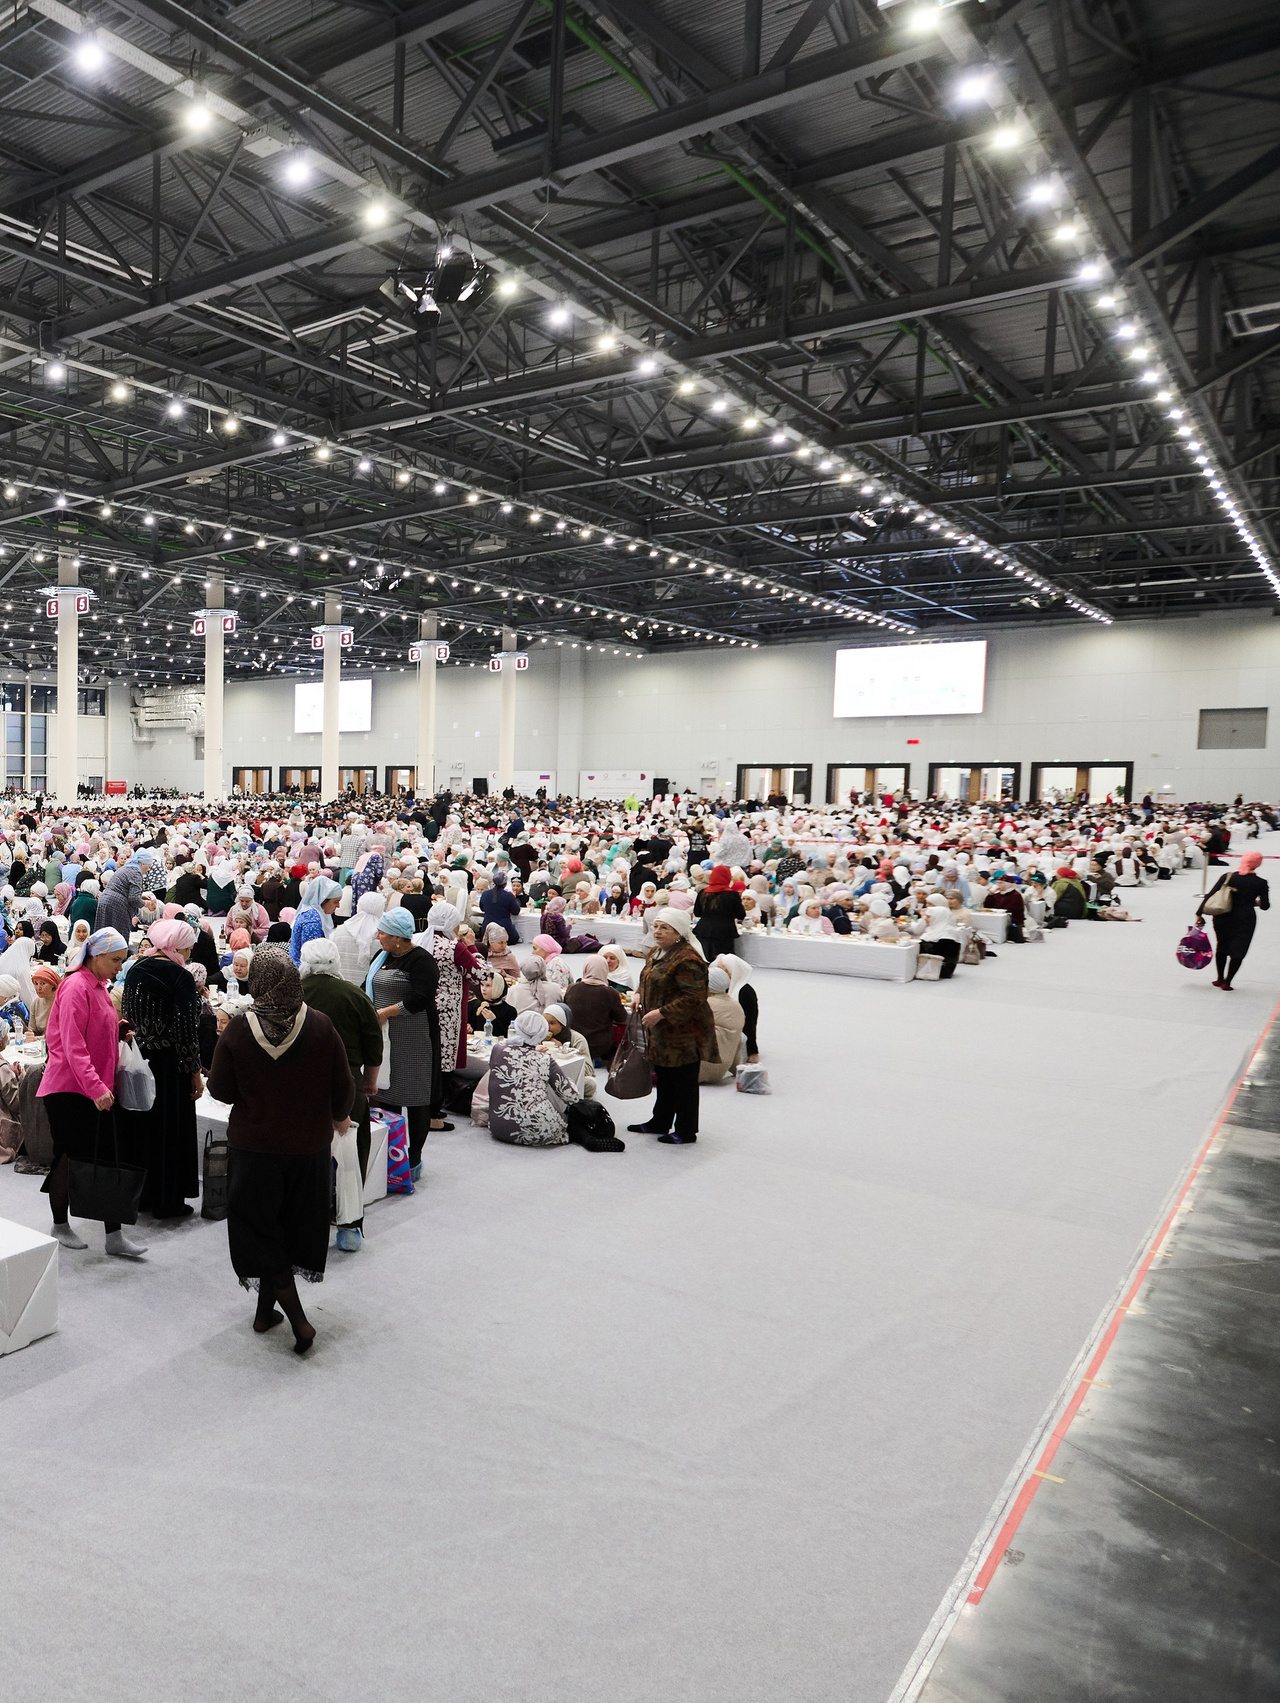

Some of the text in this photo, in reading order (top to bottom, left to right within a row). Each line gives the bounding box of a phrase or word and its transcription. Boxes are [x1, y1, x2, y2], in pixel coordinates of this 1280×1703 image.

[50, 602, 56, 613] 5
[79, 598, 85, 610] 5
[197, 622, 203, 632] 4
[225, 619, 232, 629] 4
[315, 637, 321, 646] 3
[343, 634, 349, 644] 3
